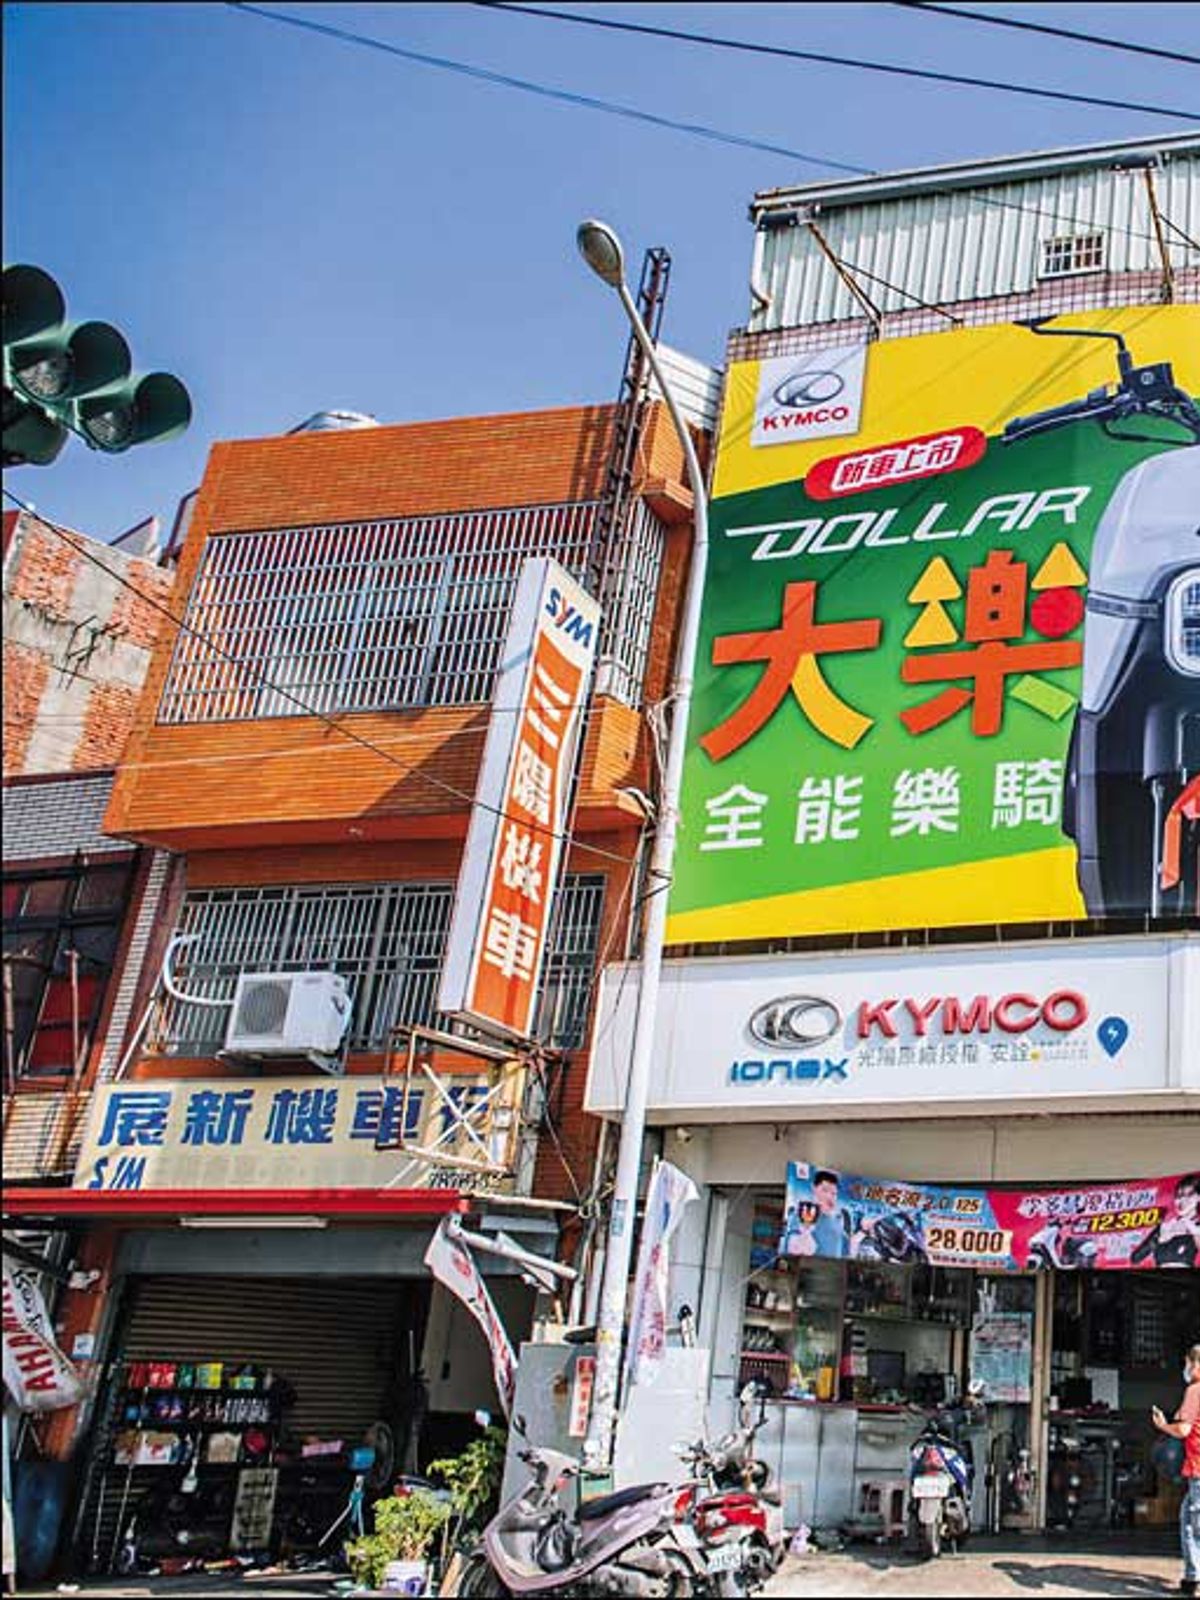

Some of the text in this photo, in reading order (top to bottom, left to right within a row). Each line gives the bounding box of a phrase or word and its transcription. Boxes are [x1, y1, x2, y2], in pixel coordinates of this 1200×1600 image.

[762, 406, 849, 431] KYMCO
[835, 436, 961, 489] 新車上市
[726, 487, 1092, 561] DOLLAR
[545, 587, 592, 650] SYM
[484, 664, 571, 982] 三陽機車
[699, 758, 1063, 852] 全能樂騎
[857, 988, 1090, 1038] KYMCO
